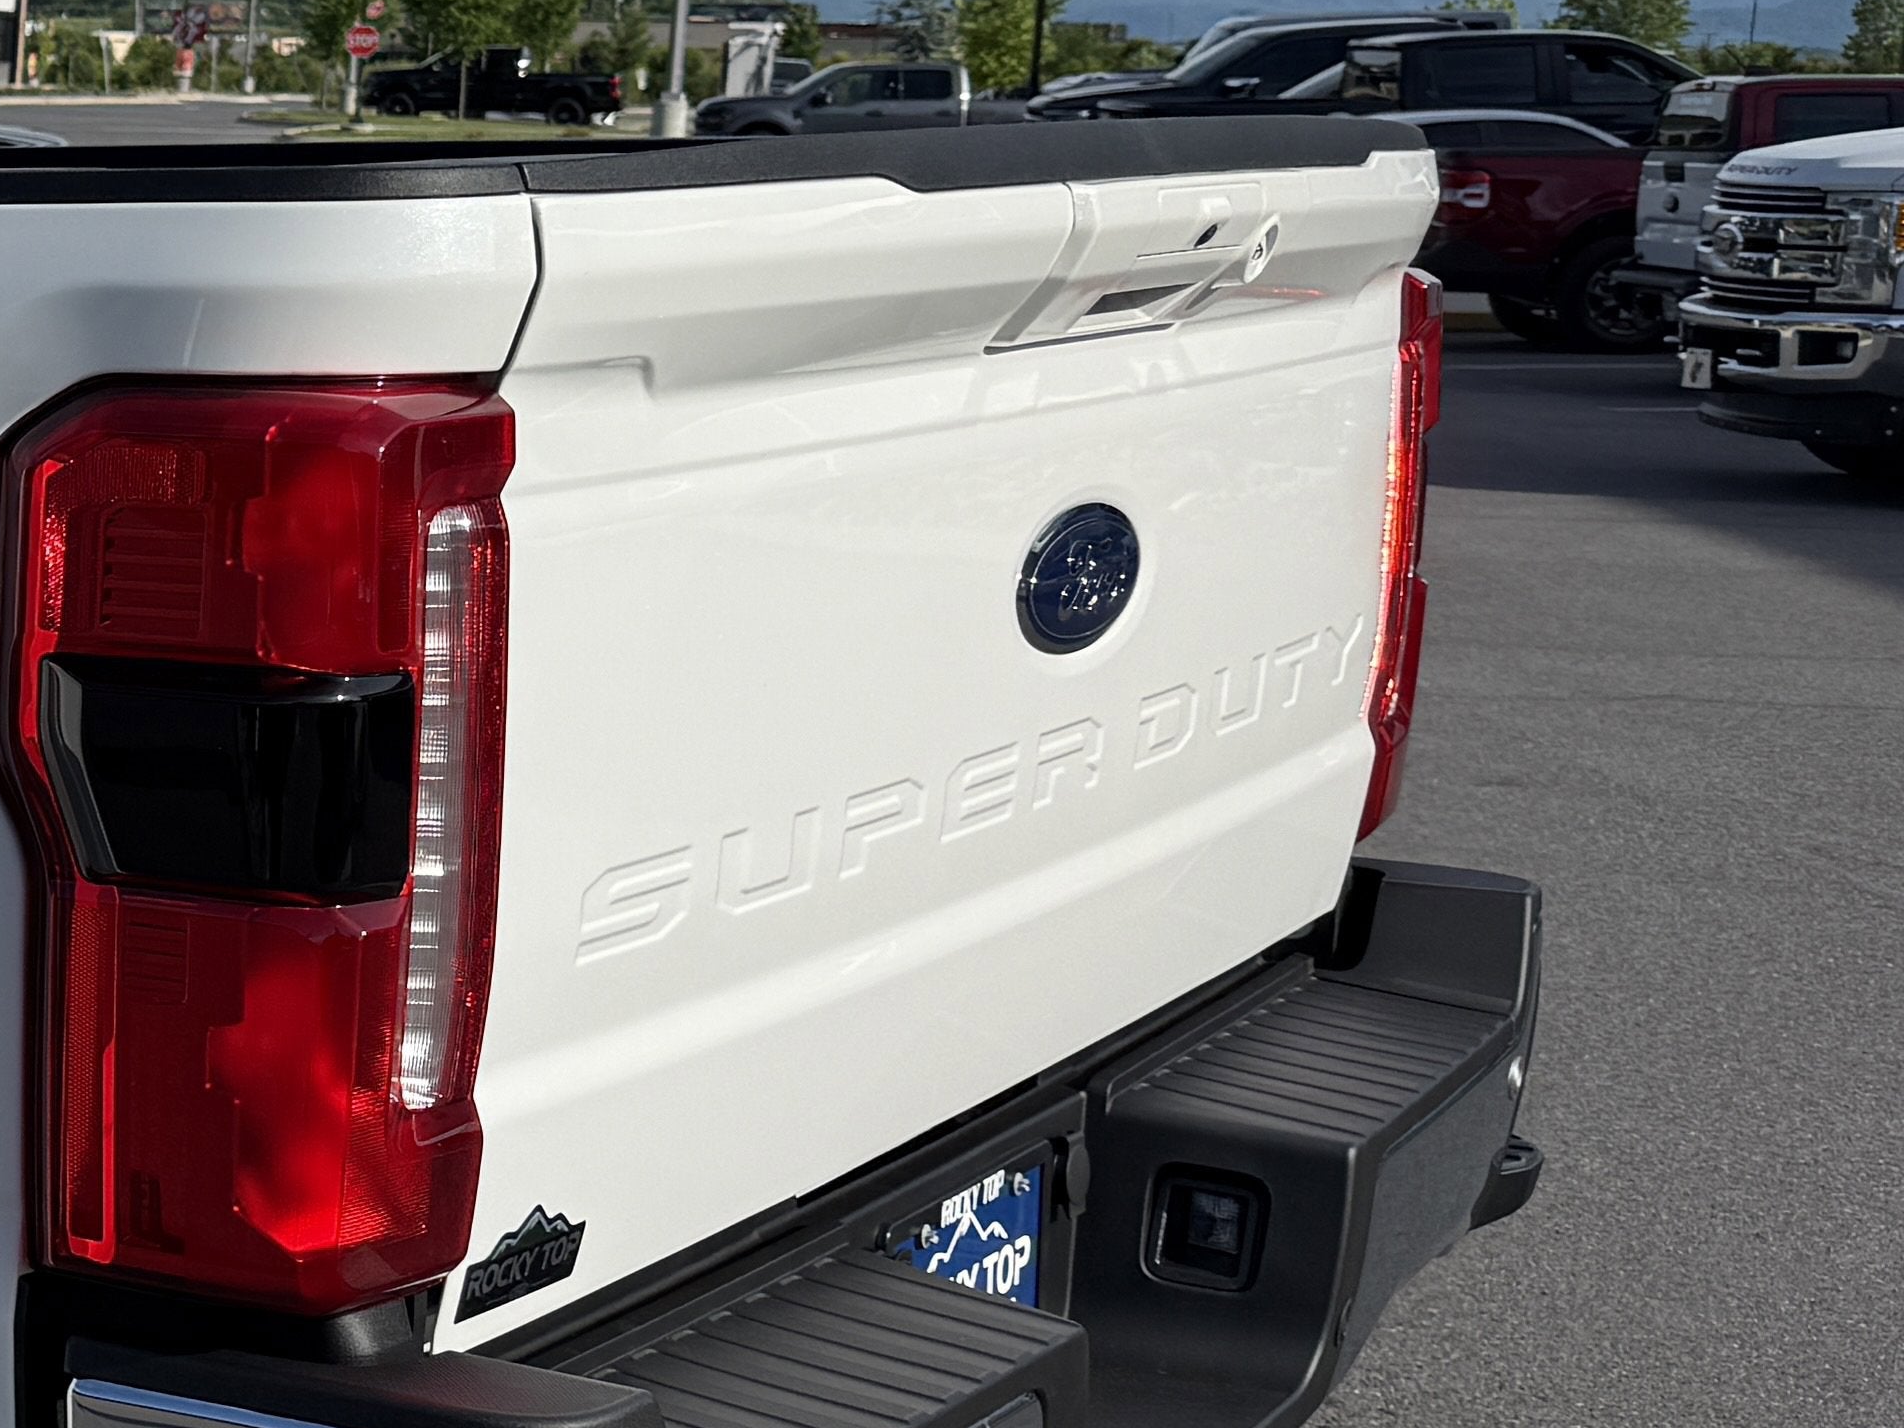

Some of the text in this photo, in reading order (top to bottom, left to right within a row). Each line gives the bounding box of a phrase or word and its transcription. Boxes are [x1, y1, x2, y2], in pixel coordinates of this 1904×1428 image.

[347, 32, 380, 48] STOP
[575, 612, 1364, 967] SUPER DUTY
[940, 1169, 1006, 1230] ROCKY TOP
[465, 1228, 582, 1301] ROCKY TOP
[982, 1234, 1032, 1295] TOP
